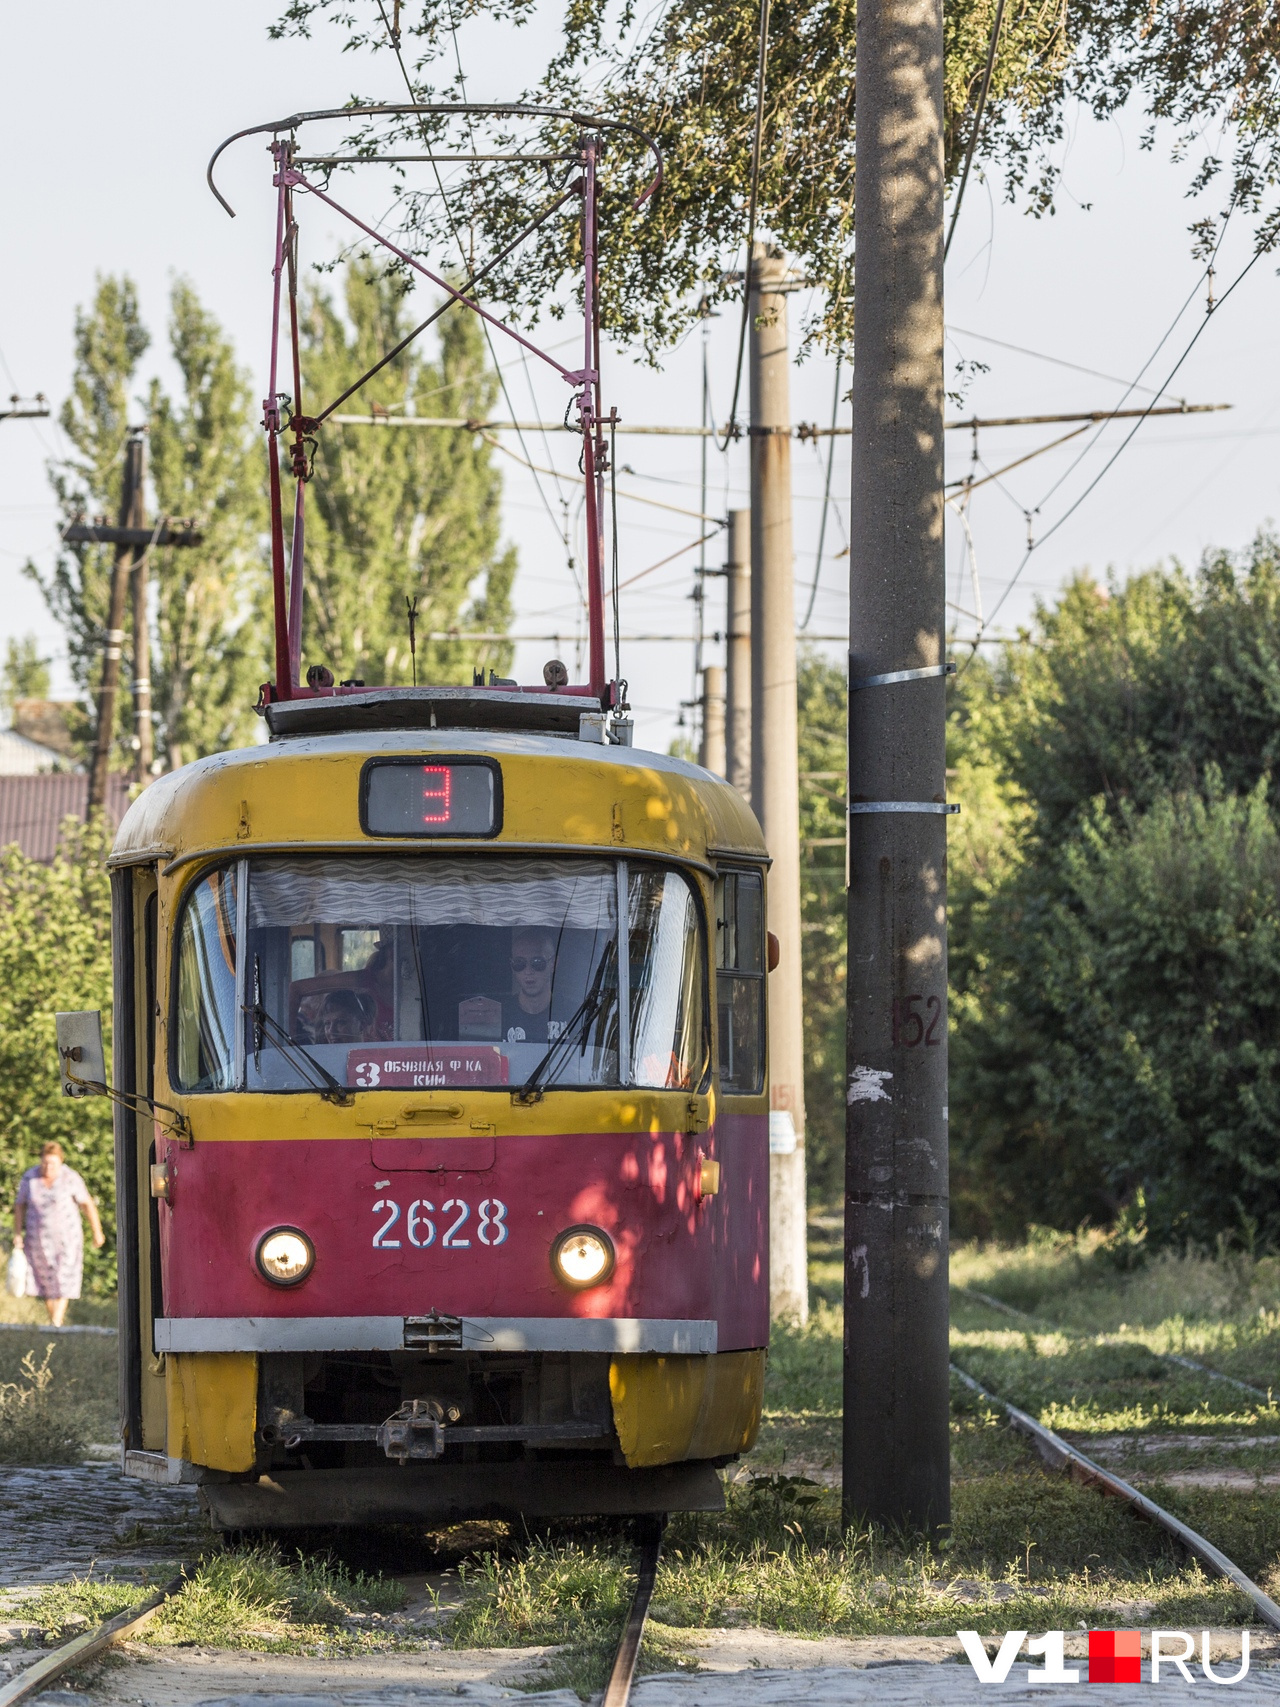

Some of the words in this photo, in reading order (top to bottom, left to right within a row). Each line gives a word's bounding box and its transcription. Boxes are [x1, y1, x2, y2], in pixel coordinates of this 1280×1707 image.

[424, 766, 450, 823] 3
[892, 994, 942, 1048] 152
[355, 1062, 381, 1087] 3
[384, 1060, 444, 1073] ОБУВНАЯ
[413, 1074, 446, 1086] КИМ
[372, 1198, 509, 1248] 2628
